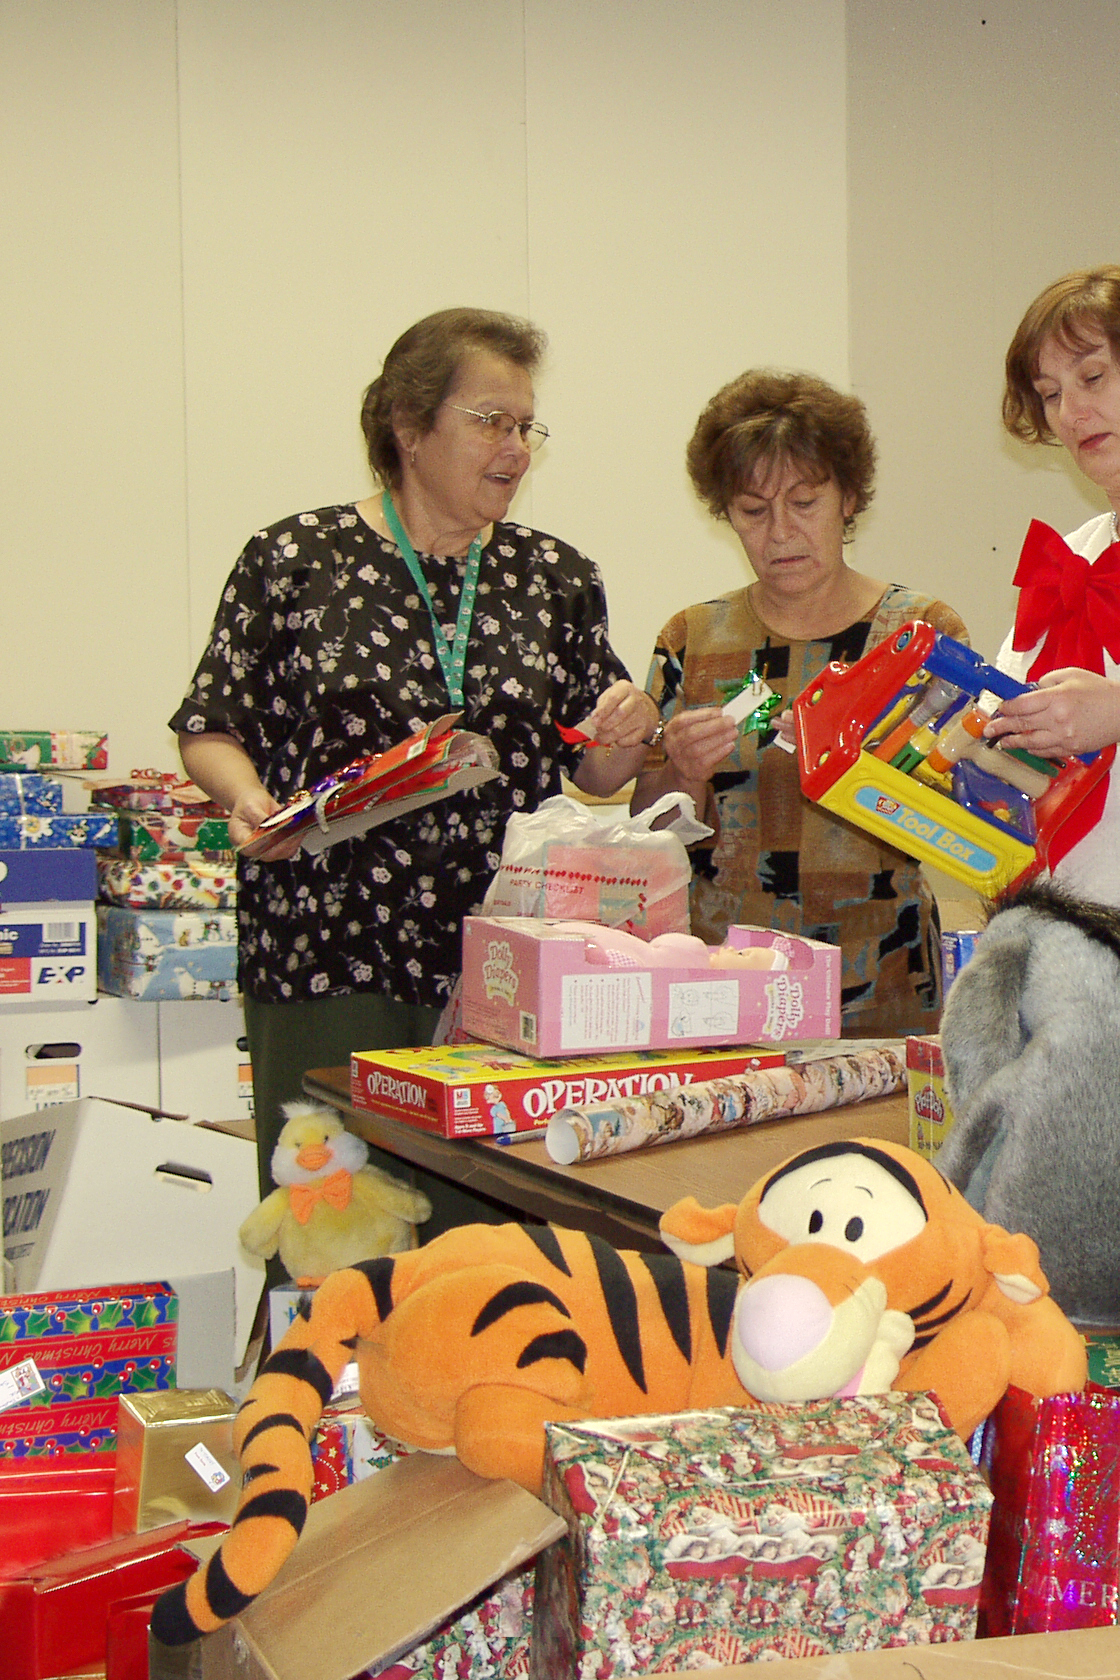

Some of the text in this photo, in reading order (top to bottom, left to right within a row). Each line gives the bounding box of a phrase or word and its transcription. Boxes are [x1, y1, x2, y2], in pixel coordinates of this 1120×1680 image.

[896, 807, 975, 861] Tool Box
[510, 878, 585, 895] PARTY CHECKLIST
[774, 976, 787, 1036] Diapers
[787, 984, 801, 1026] Dolly
[367, 1071, 427, 1108] OPERATION
[523, 1072, 695, 1118] OPERATION
[23, 1343, 103, 1361] Christmas
[108, 1334, 157, 1354] Merry
[62, 1409, 109, 1428] Merry
